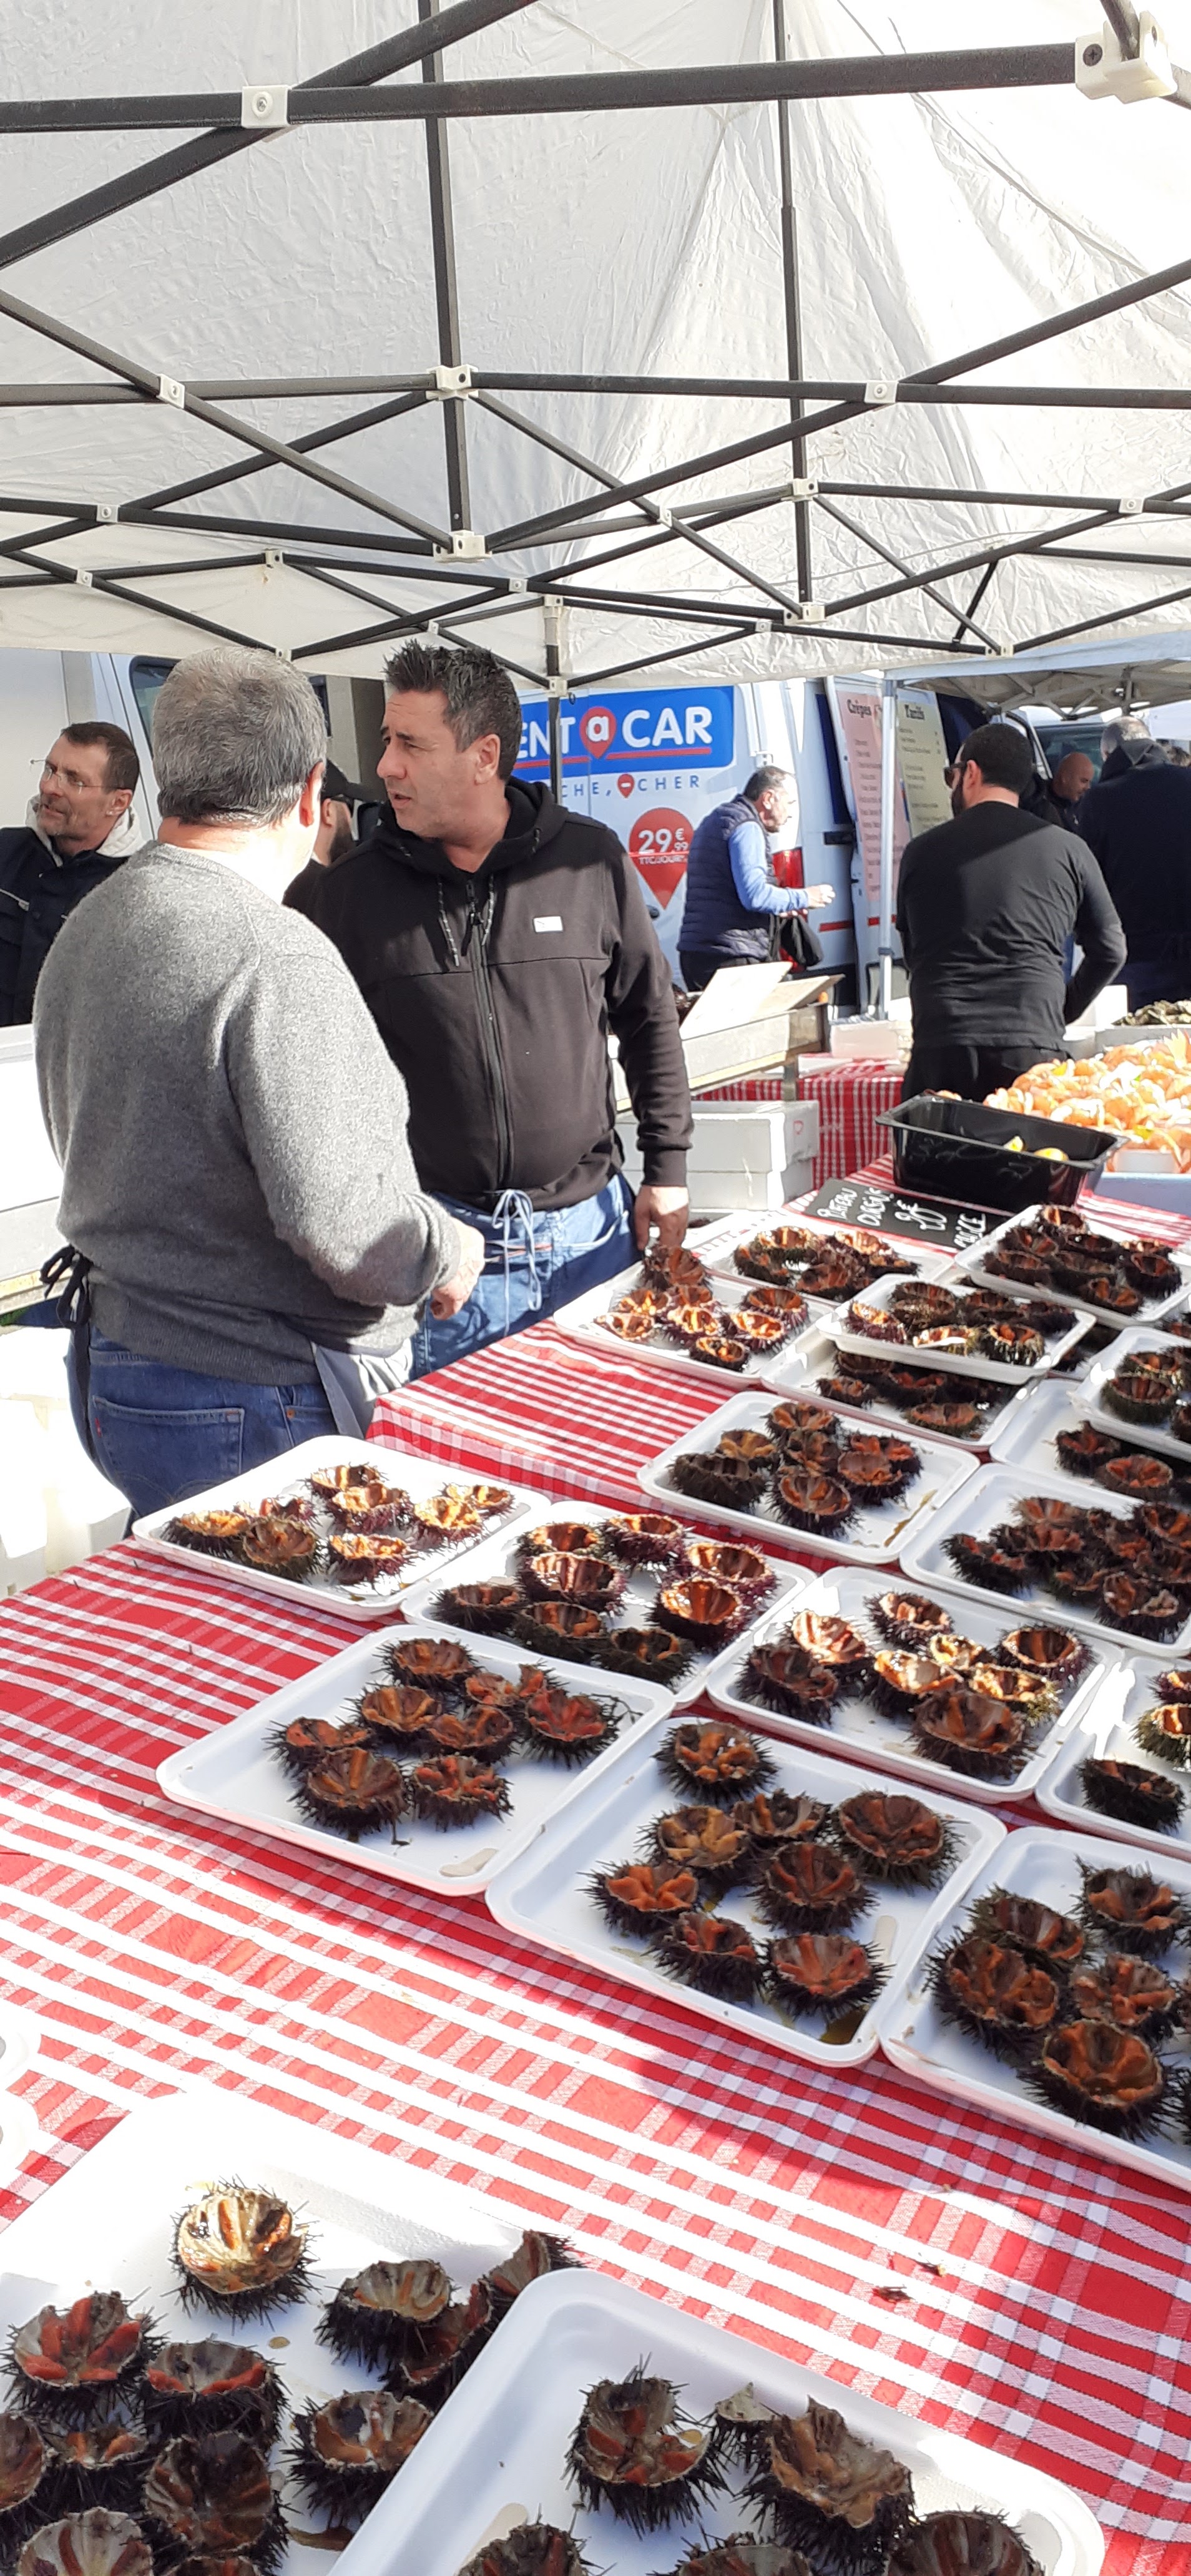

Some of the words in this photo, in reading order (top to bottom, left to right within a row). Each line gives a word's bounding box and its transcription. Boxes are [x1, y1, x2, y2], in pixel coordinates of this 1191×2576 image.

[516, 717, 576, 759] ENT
[586, 715, 609, 742] a
[622, 706, 713, 748] CAR
[562, 781, 611, 798] CHE,
[637, 774, 700, 791] CHER
[638, 828, 672, 854] 29
